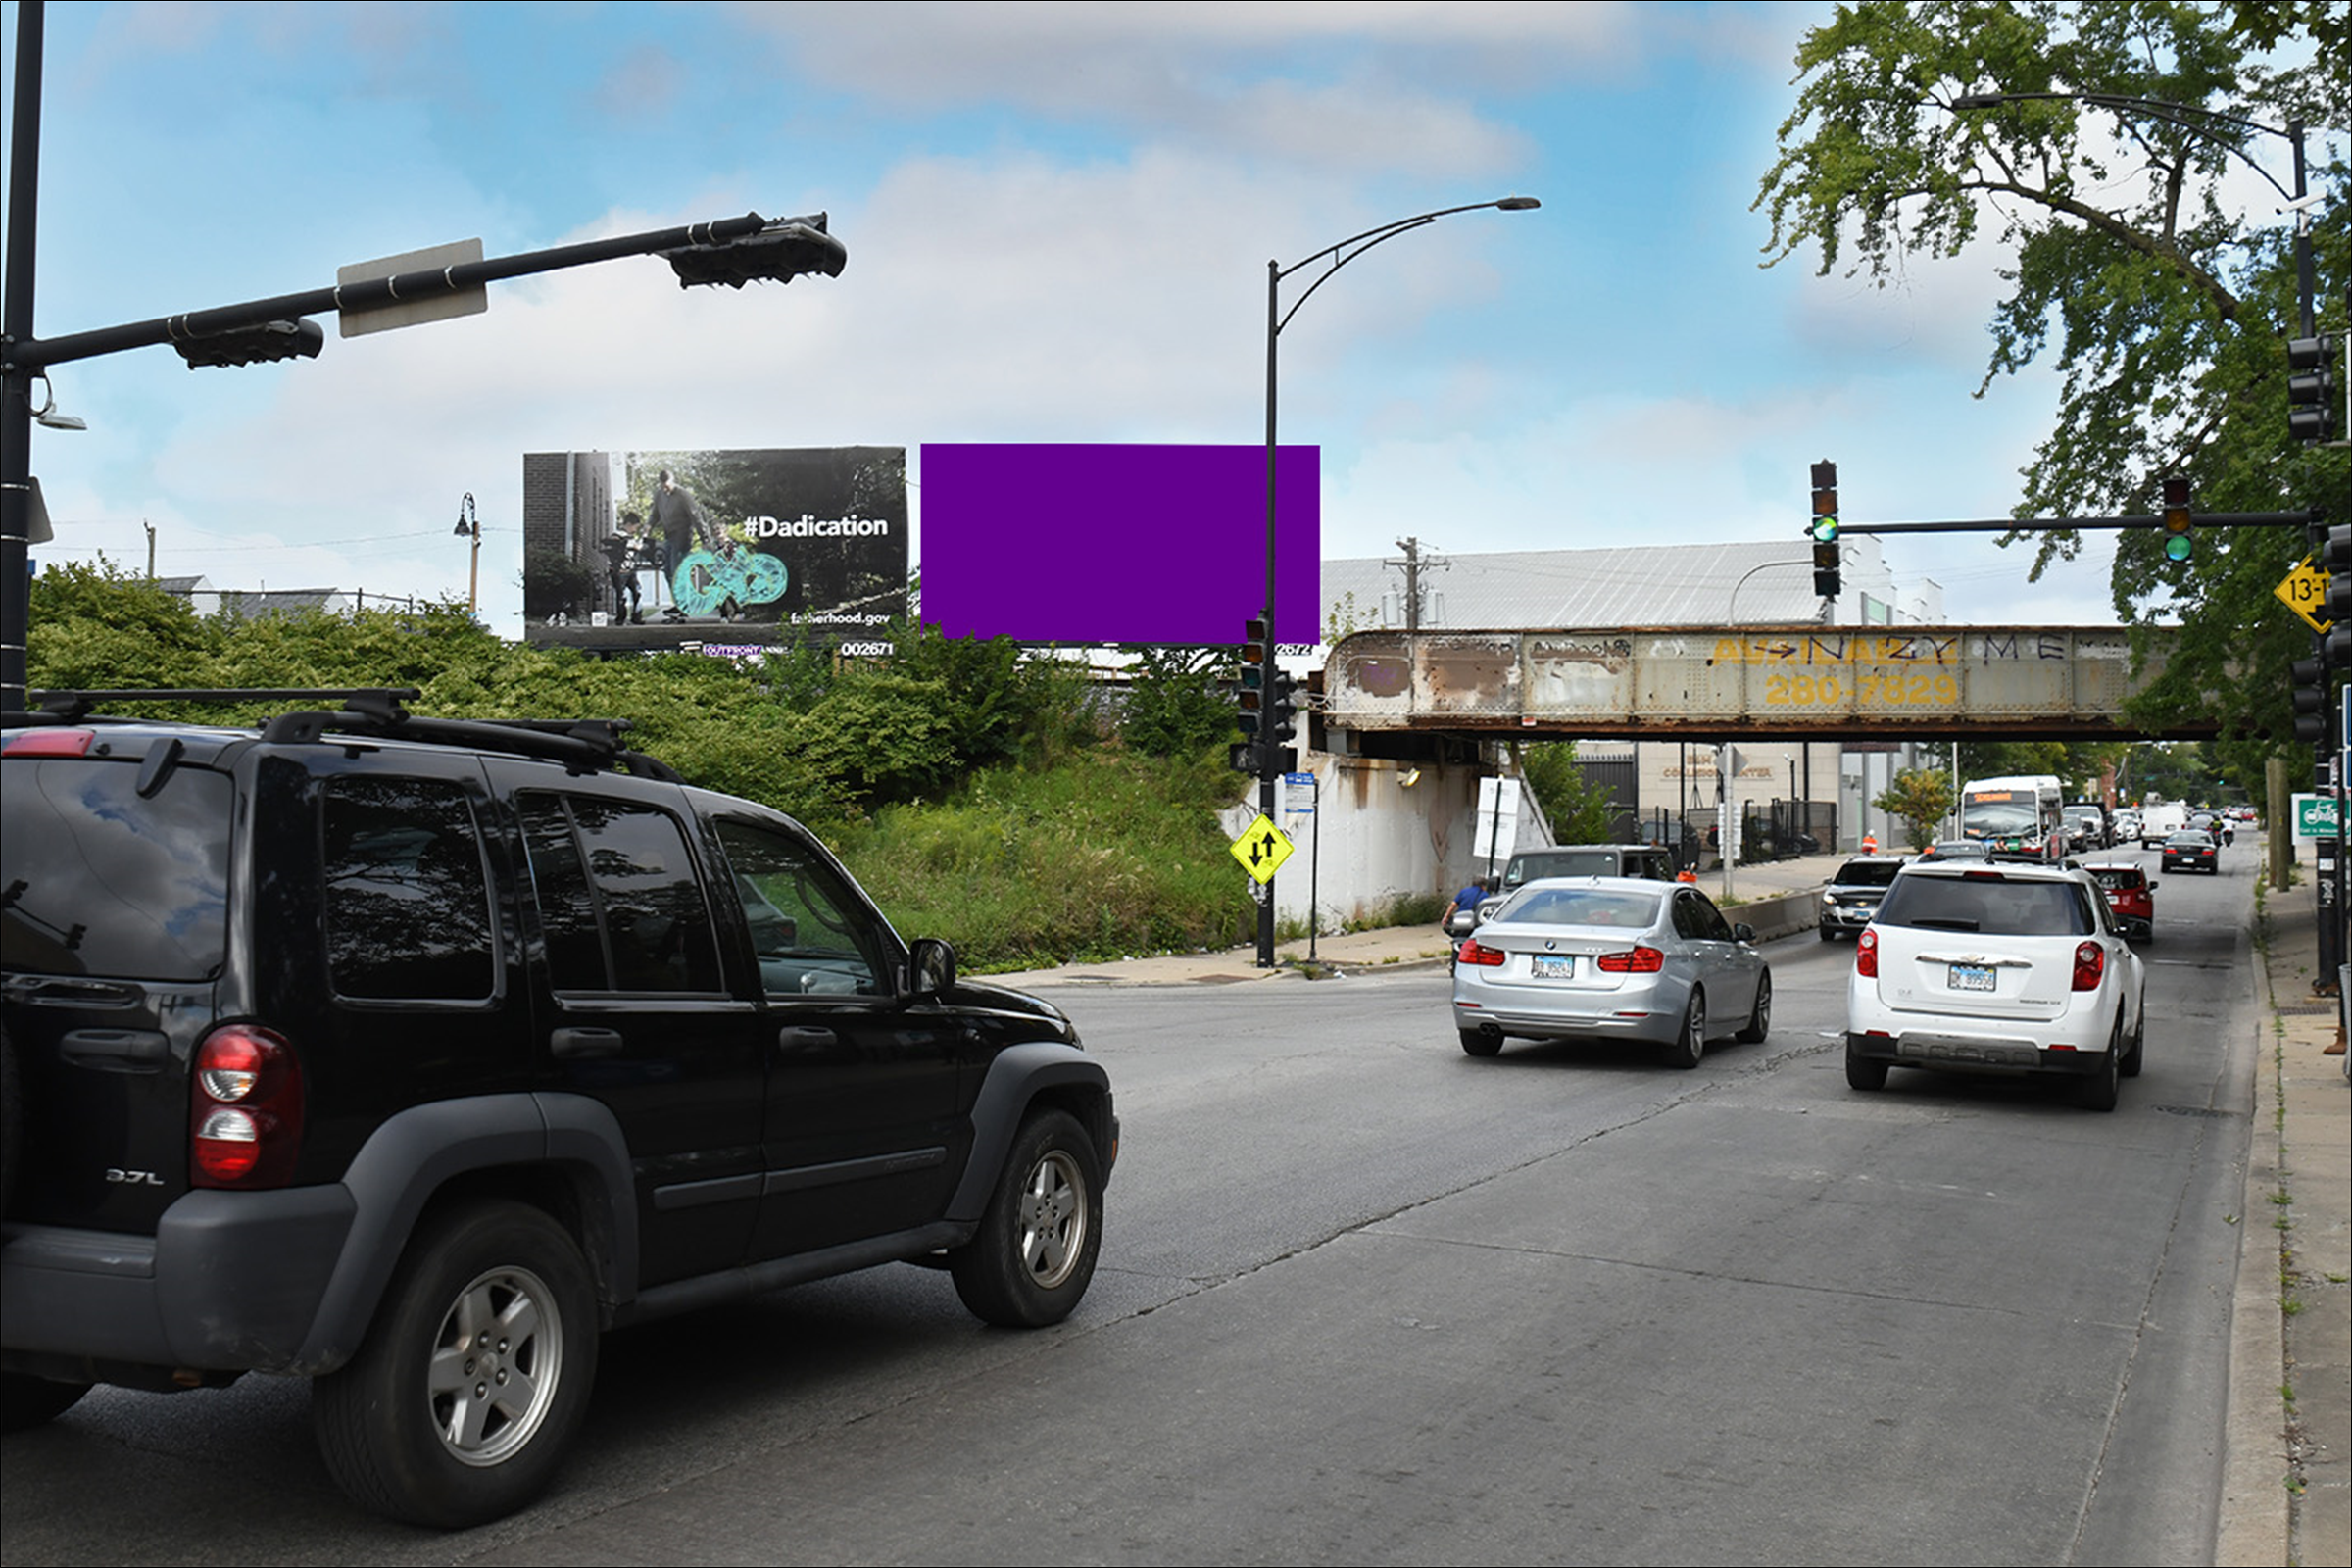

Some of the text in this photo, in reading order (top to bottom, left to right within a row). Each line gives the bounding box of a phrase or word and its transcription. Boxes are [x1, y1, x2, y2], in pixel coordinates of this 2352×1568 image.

[743, 514, 888, 537] #Dadication
[790, 611, 890, 626] faherhood.gov
[841, 642, 893, 656] 002671
[1765, 674, 1958, 706] 280-7829
